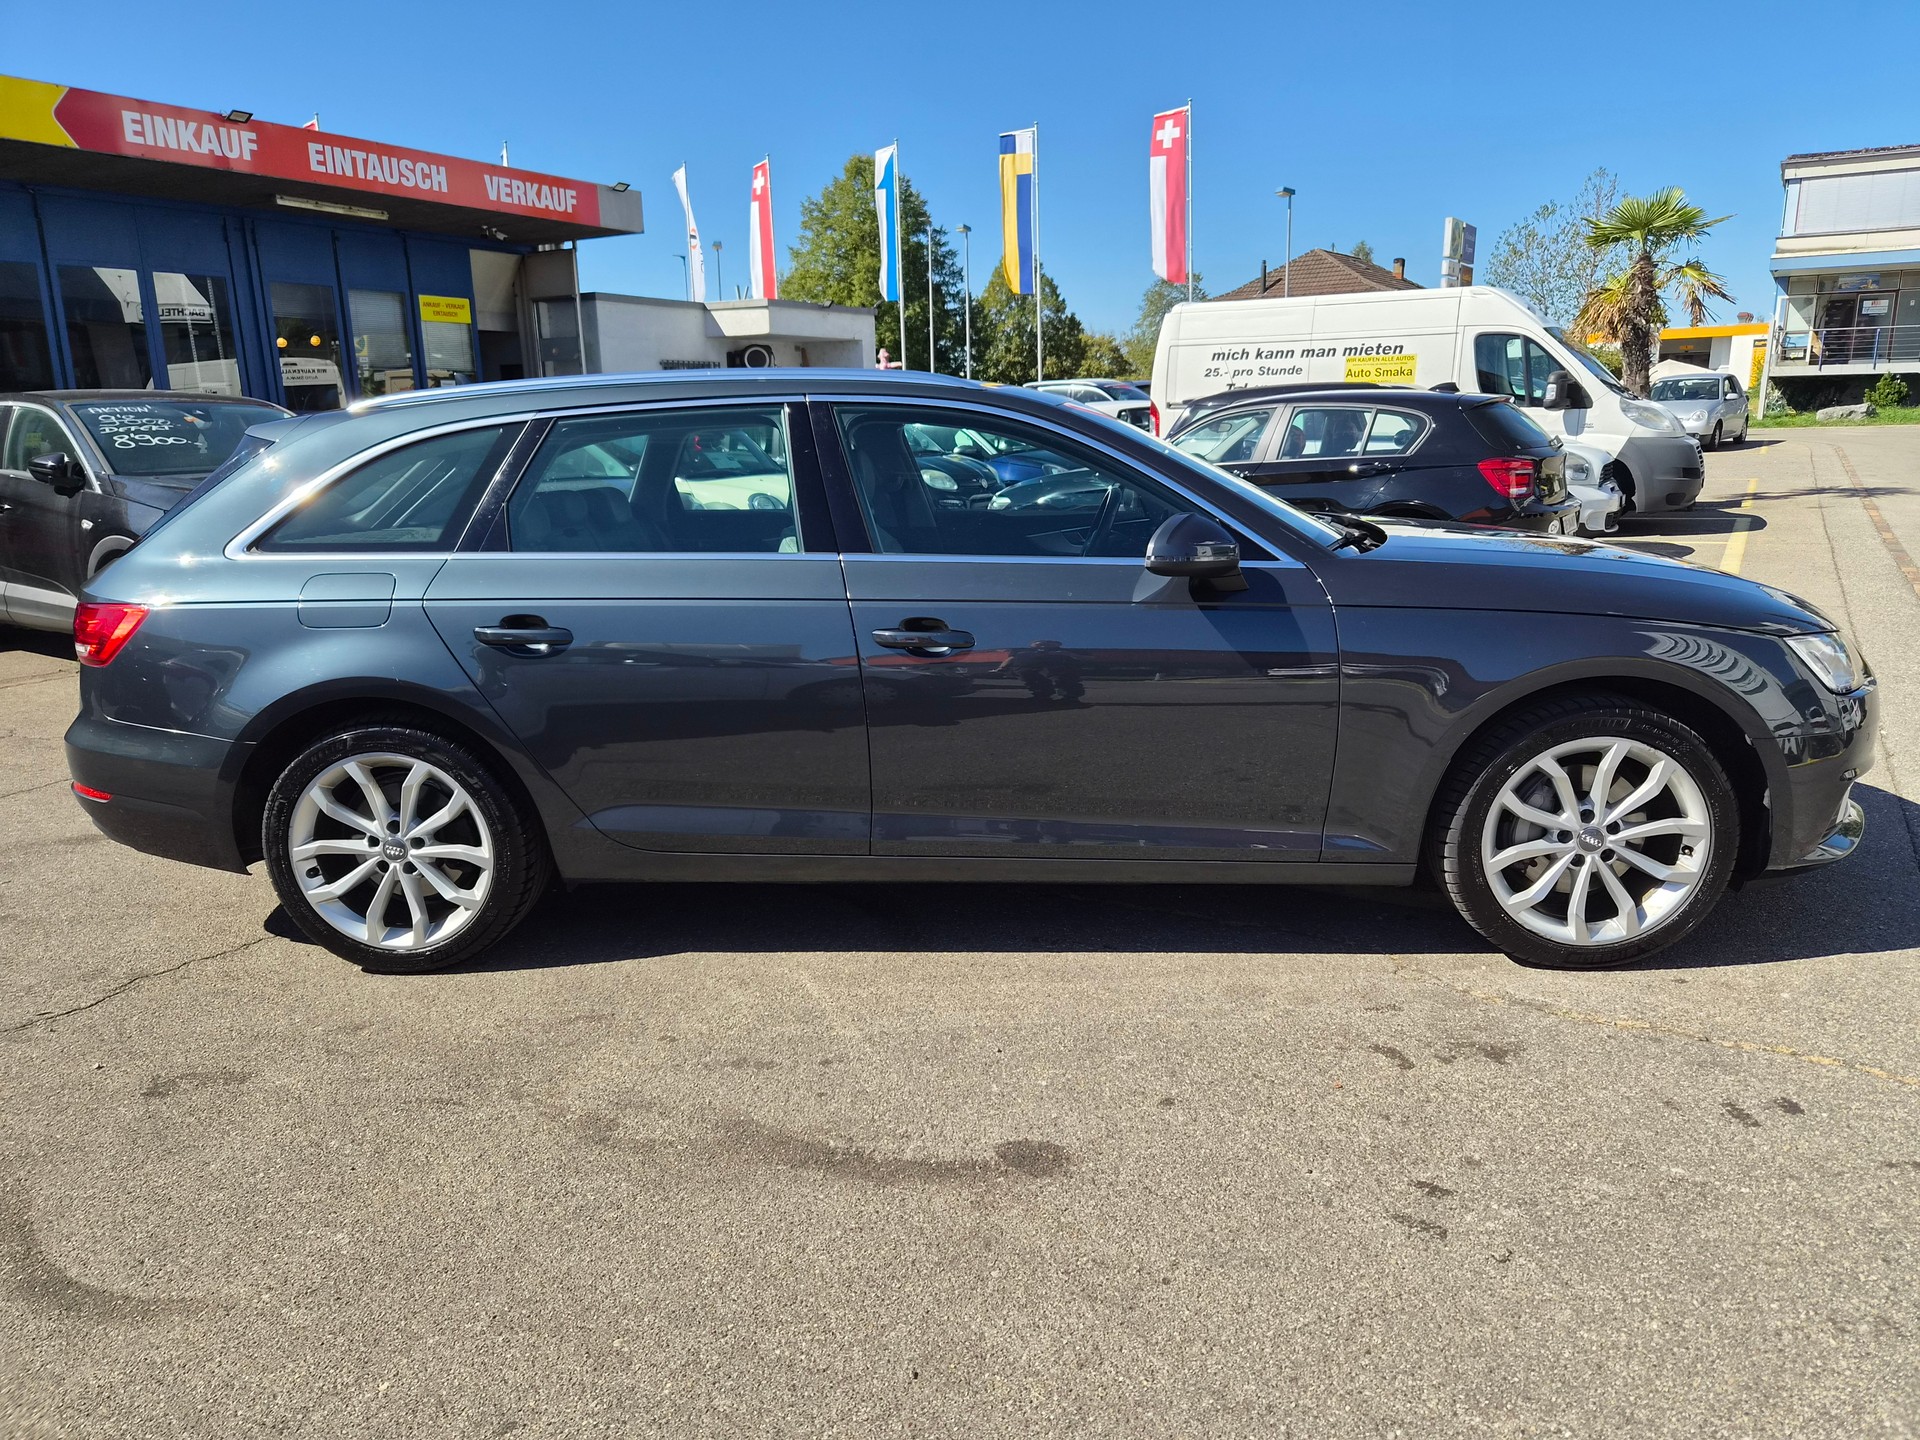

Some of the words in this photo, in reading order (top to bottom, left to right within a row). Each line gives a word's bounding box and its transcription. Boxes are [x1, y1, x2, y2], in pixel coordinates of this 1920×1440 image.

[121, 110, 258, 161] EINKAUF
[307, 141, 448, 193] EINTAUSCH
[483, 174, 577, 213] VERKAUF
[422, 301, 441, 309] ANKAUF
[445, 302, 466, 310] VERKAUF
[432, 310, 458, 318] EINTAUSCH
[1211, 348, 1250, 361] mich
[1255, 347, 1295, 360] kann
[1300, 346, 1337, 358] man
[1342, 343, 1404, 357] mieten
[1204, 368, 1228, 377] 25.-
[1232, 368, 1254, 379] pro
[1258, 364, 1303, 376] Stunde
[1345, 368, 1372, 378] Auto
[1374, 365, 1413, 377] Smaka
